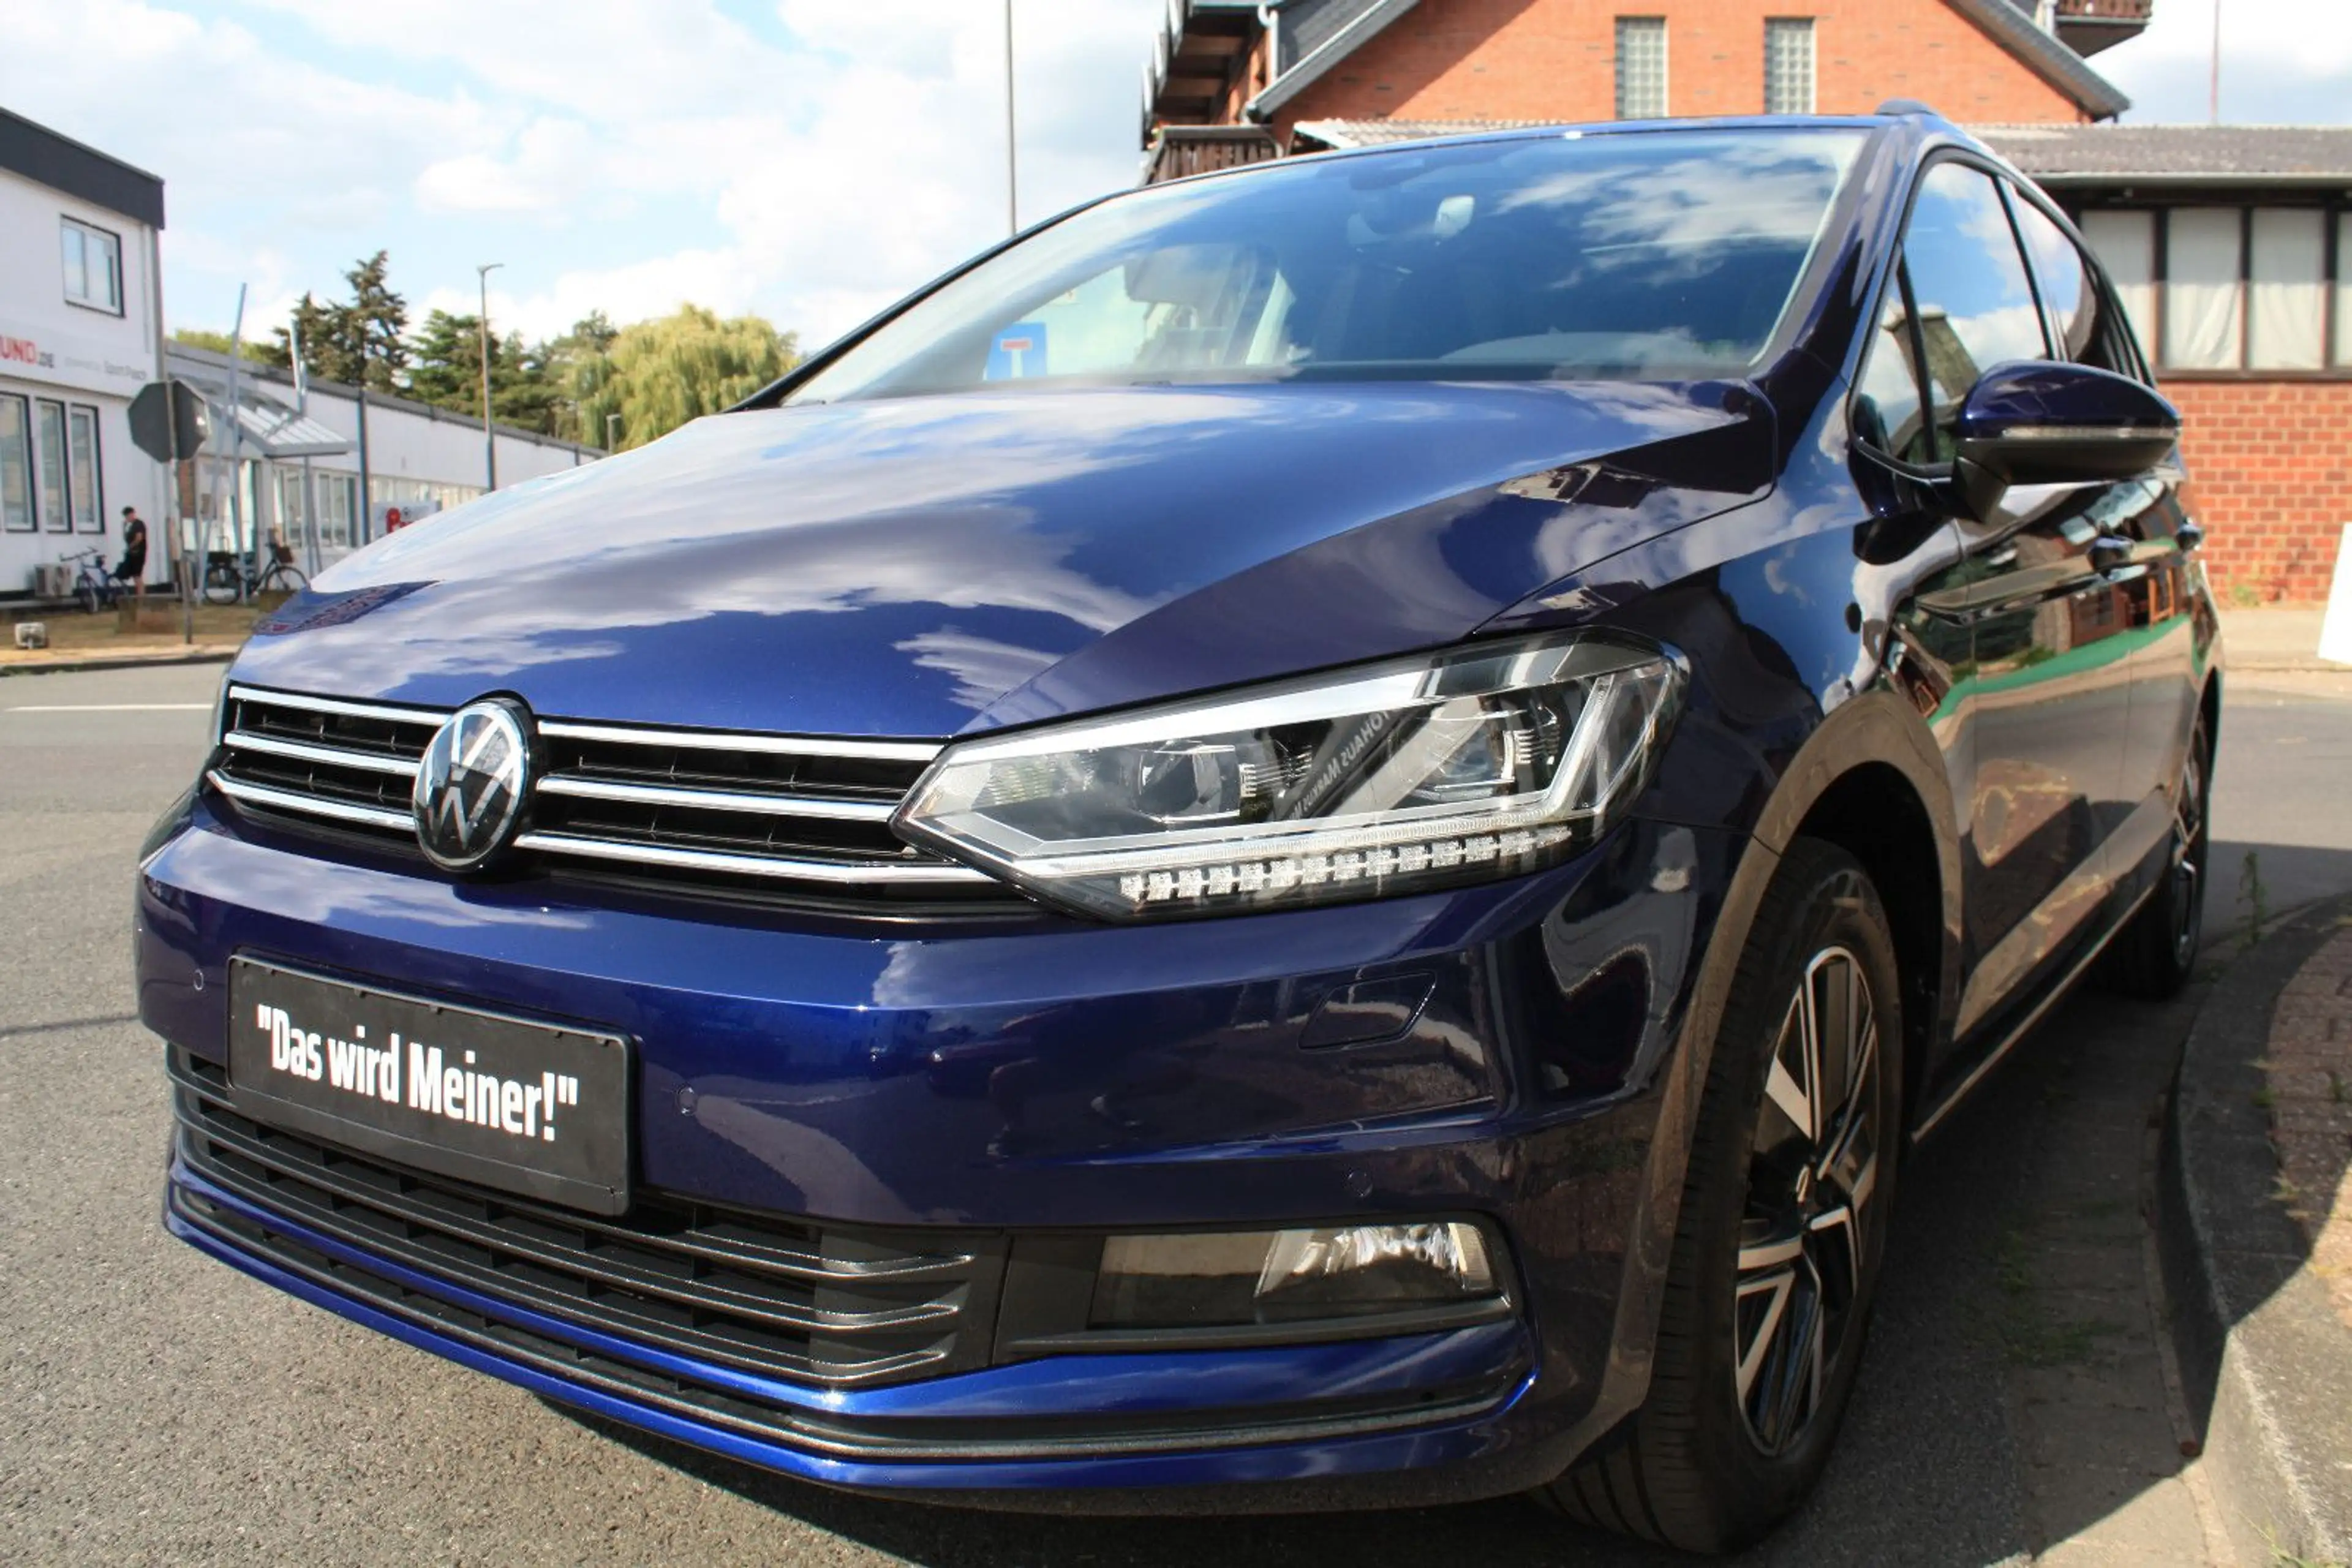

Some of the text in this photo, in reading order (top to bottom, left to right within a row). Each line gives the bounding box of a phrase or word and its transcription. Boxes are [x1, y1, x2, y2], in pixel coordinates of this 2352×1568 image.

[424, 712, 521, 851] VW
[257, 1003, 578, 1142] "Das wird Meiner!"
